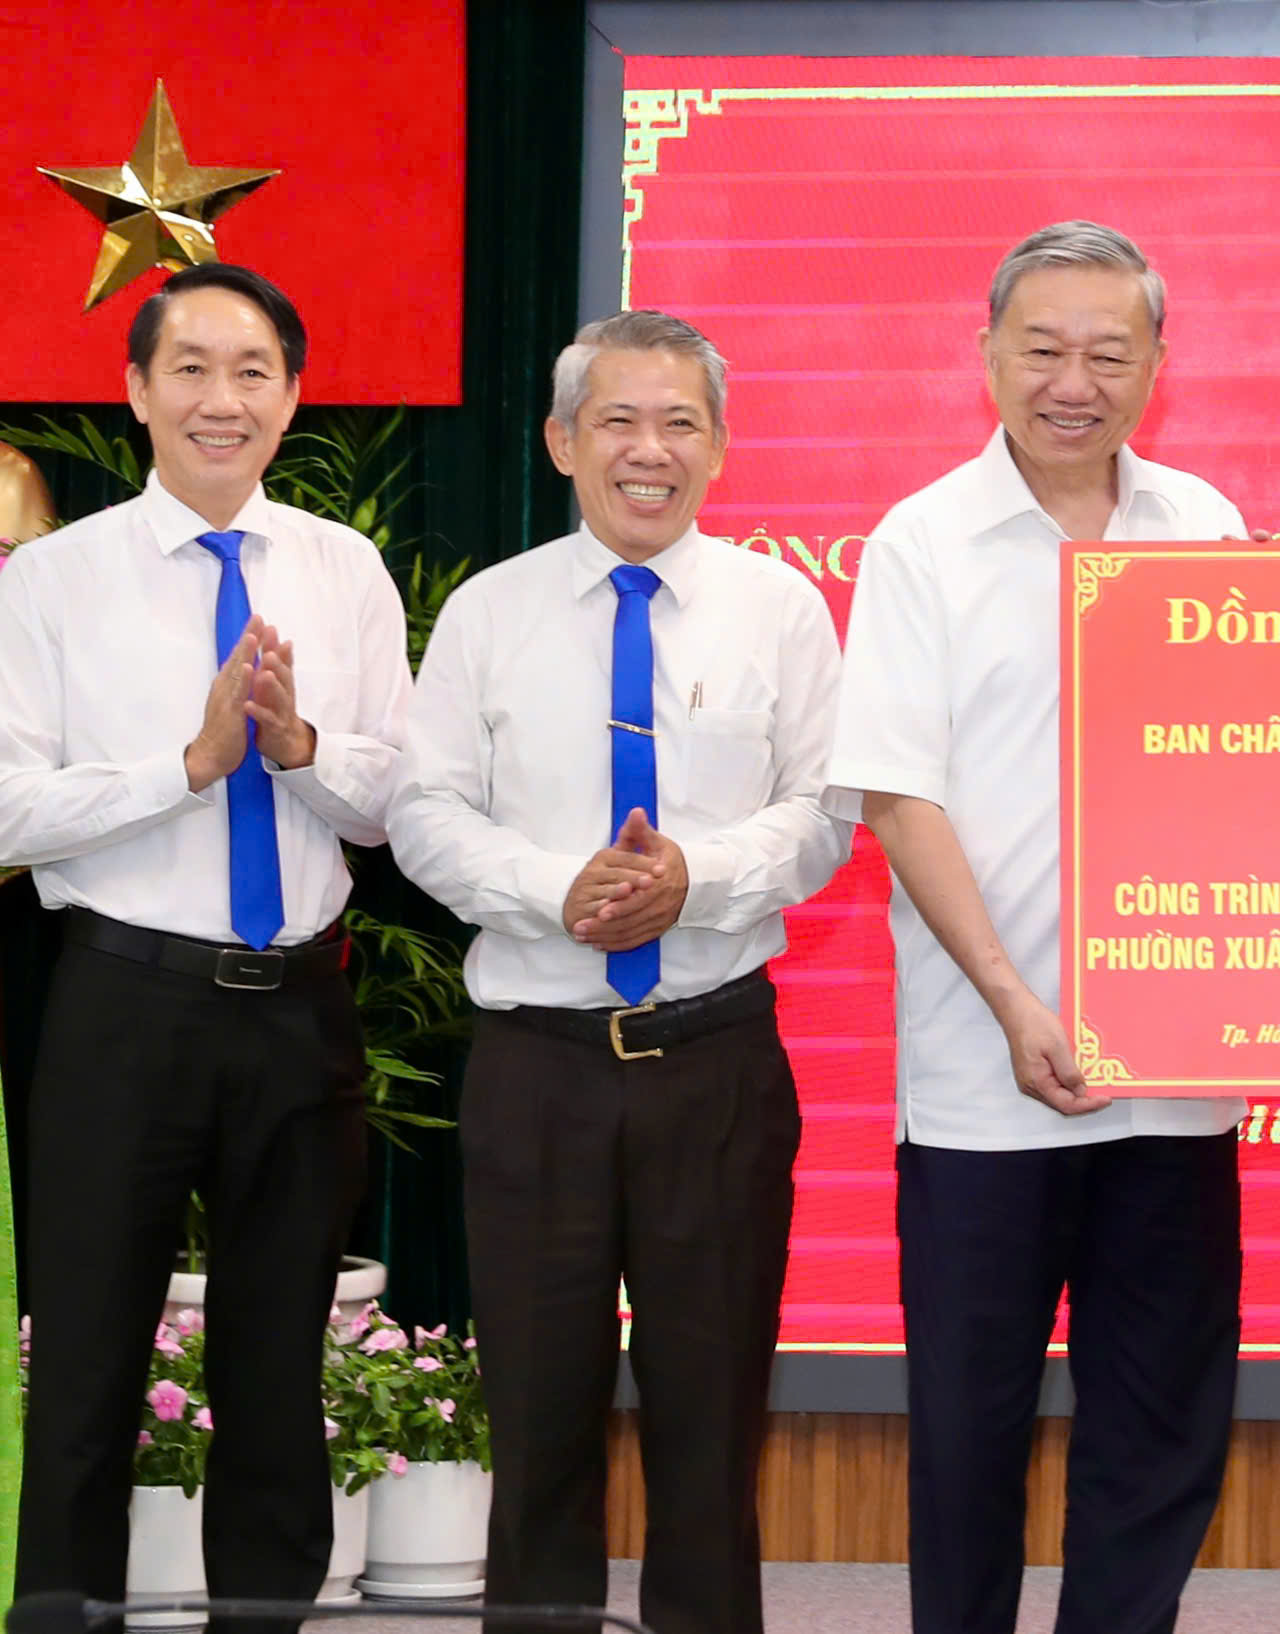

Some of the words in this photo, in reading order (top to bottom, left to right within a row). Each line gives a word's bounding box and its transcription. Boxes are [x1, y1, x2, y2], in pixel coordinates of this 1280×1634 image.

[1143, 724, 1210, 753] BAN
[1115, 874, 1200, 916] CÔNG
[1087, 930, 1214, 971] PHƯỜNG
[1221, 1023, 1250, 1048] Tp.
